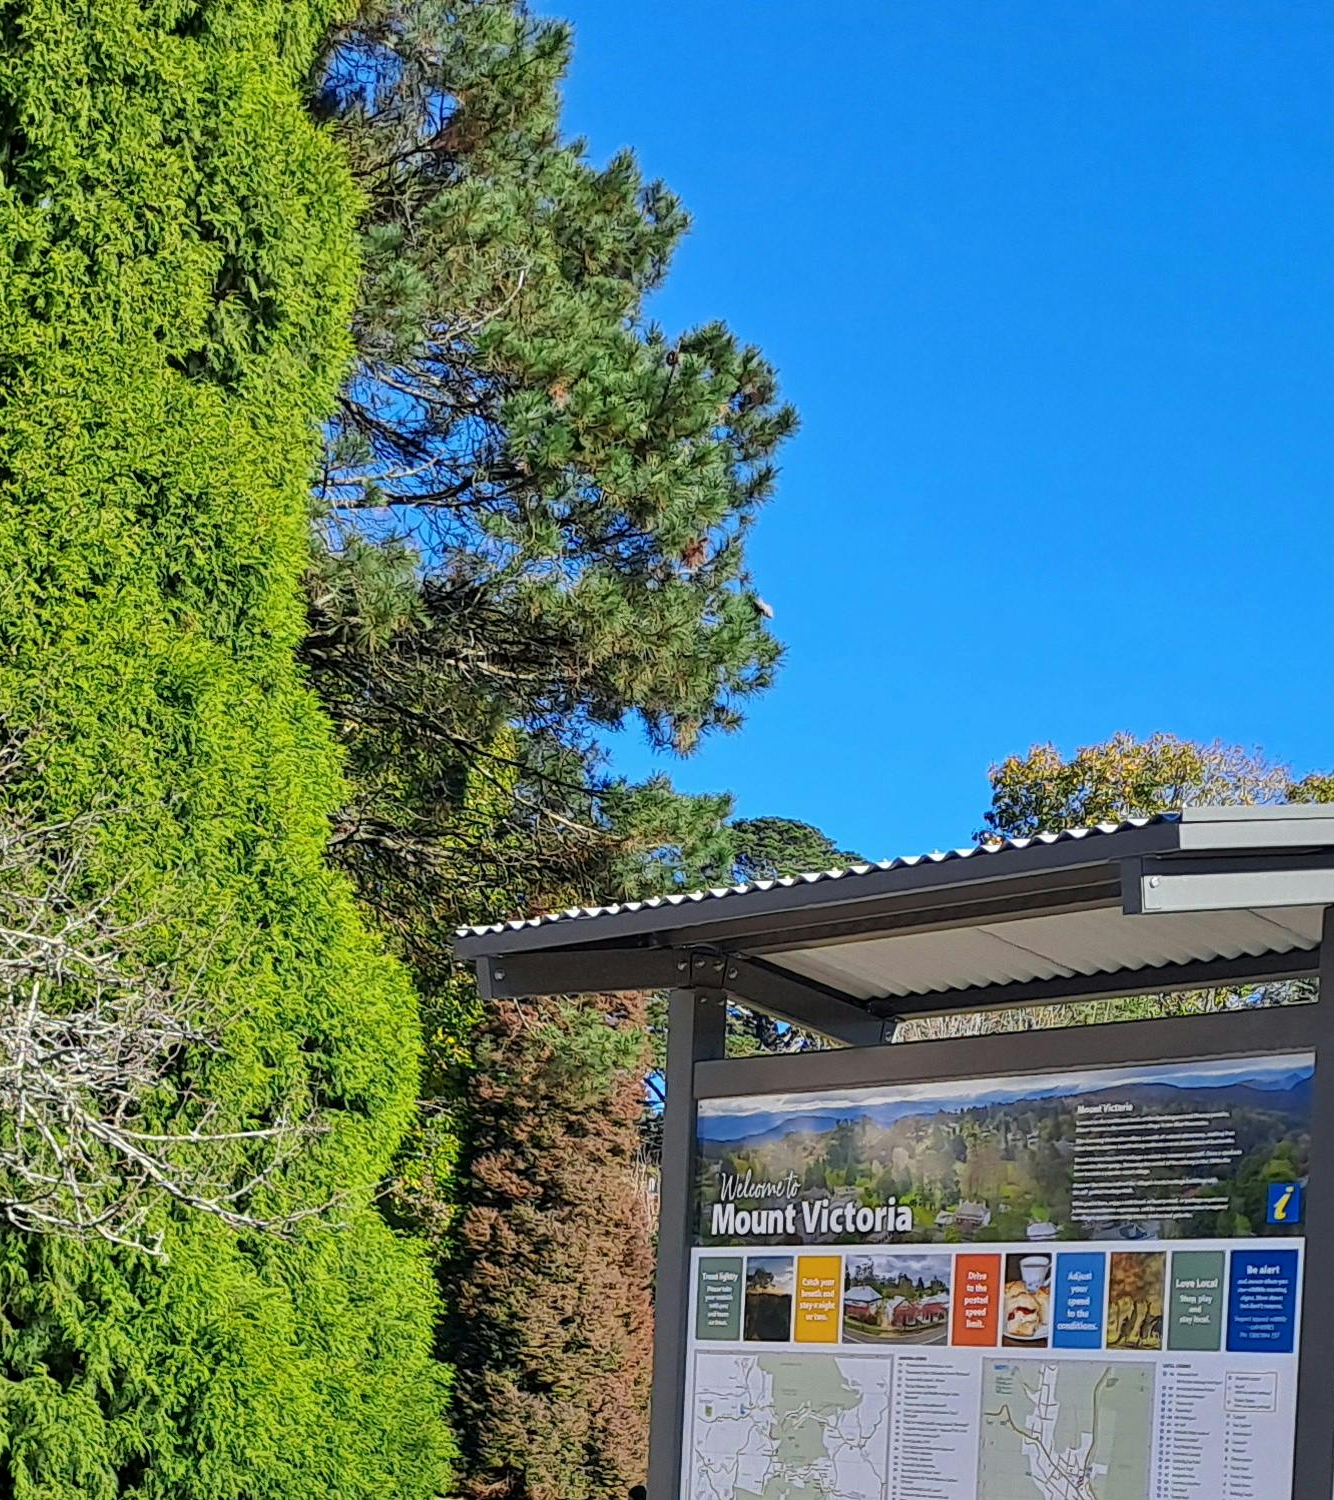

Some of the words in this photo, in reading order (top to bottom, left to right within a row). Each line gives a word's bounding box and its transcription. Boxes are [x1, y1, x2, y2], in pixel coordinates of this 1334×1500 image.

[720, 1168, 783, 1201] Welcome
[784, 1170, 802, 1198] to
[711, 1201, 796, 1236] Mount
[801, 1196, 913, 1234] Victoria
[1246, 1264, 1259, 1275] Be
[1259, 1264, 1281, 1275] alert
[1175, 1278, 1195, 1289] Love
[1196, 1277, 1219, 1289] Local
